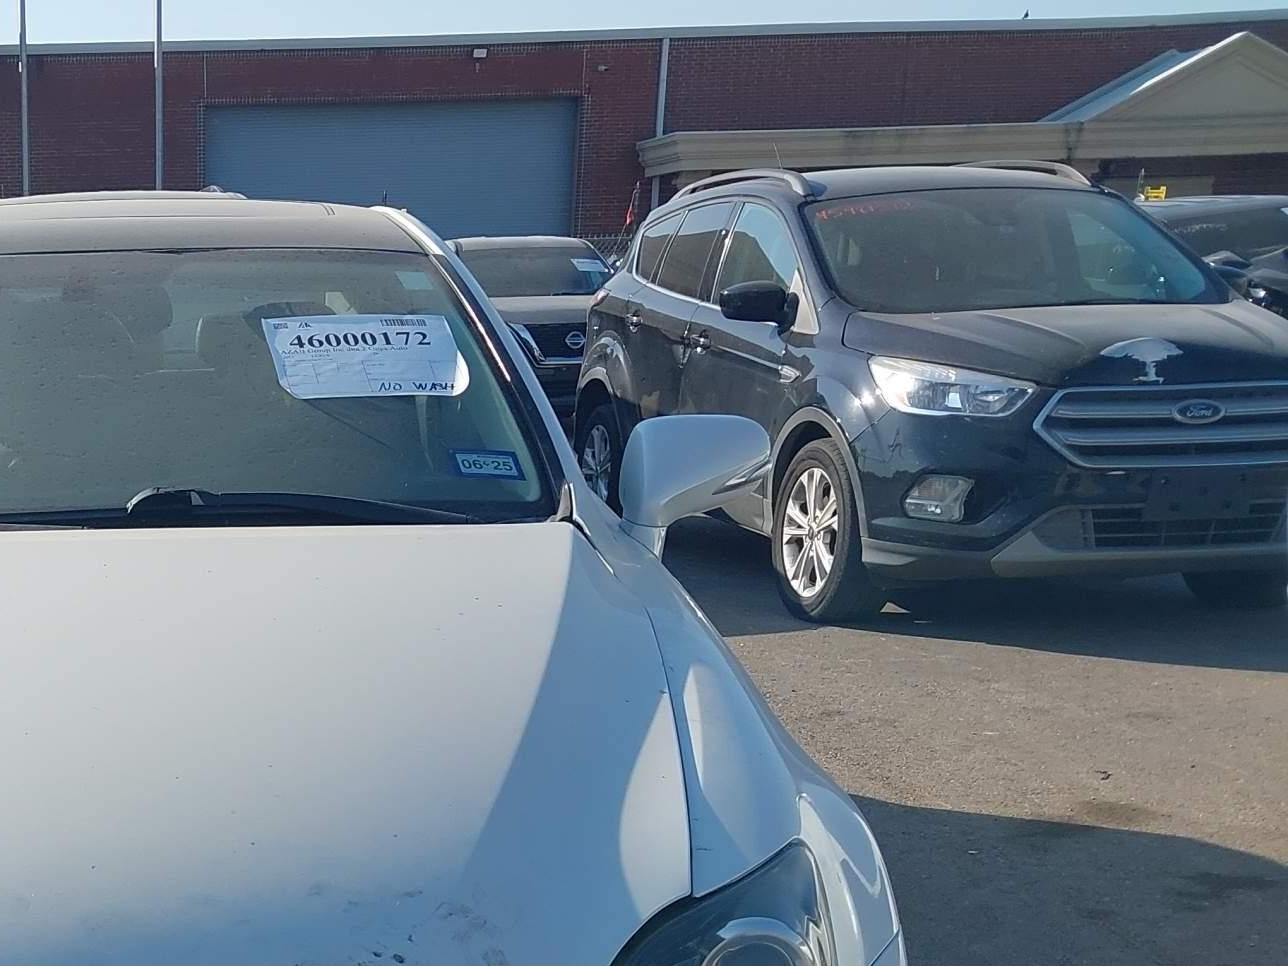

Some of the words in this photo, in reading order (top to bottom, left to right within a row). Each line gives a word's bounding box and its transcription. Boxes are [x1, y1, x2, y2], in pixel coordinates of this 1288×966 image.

[289, 331, 431, 349] 46000172
[378, 382, 402, 392] NO
[412, 382, 455, 391] WASH
[1186, 405, 1213, 417] Ford
